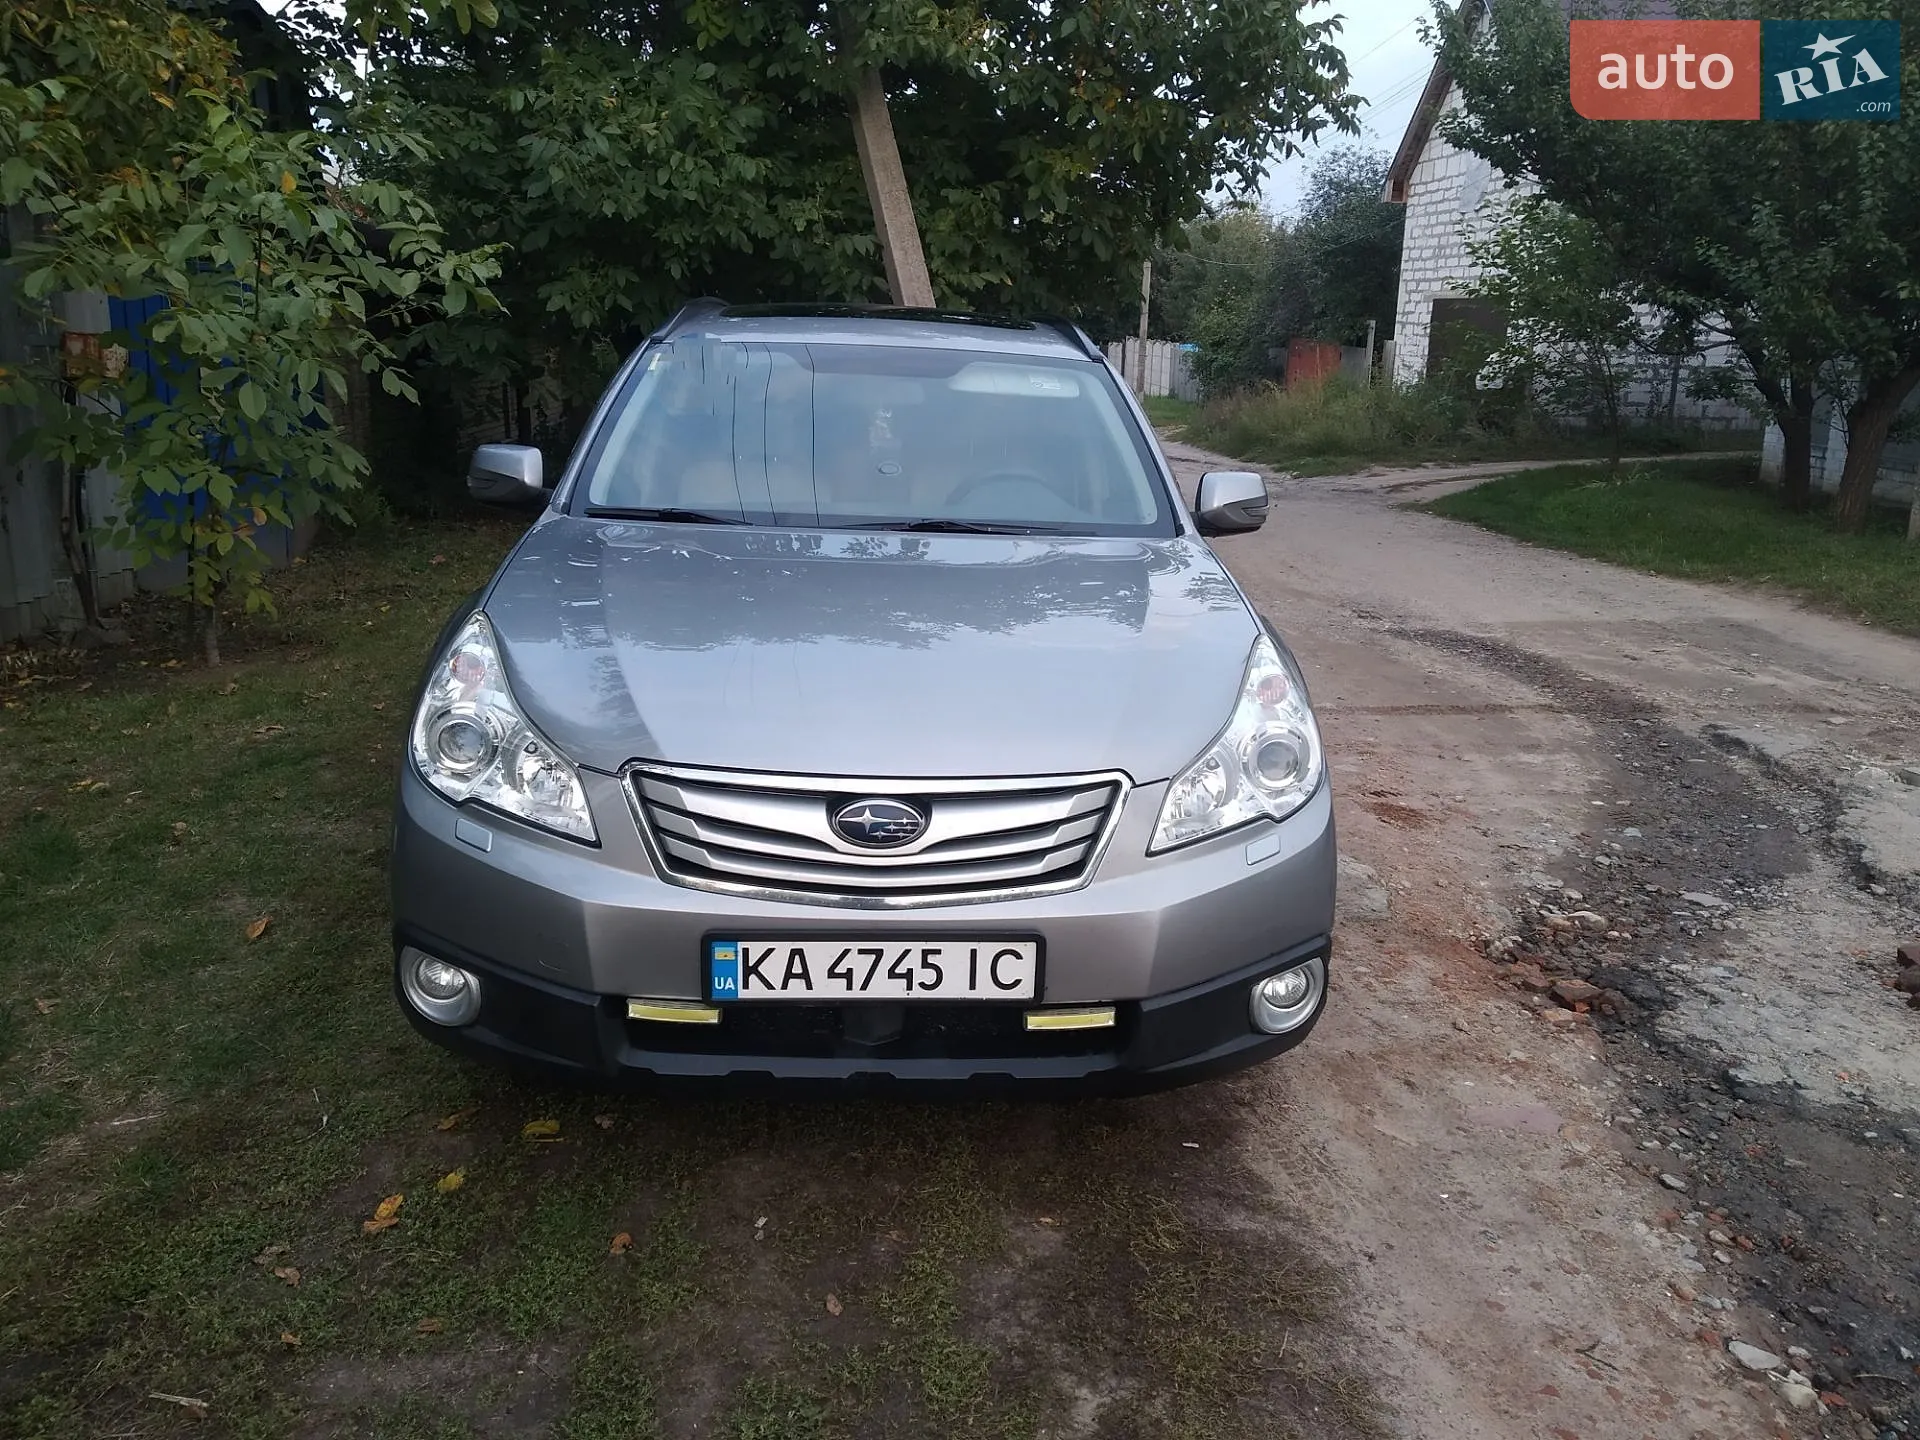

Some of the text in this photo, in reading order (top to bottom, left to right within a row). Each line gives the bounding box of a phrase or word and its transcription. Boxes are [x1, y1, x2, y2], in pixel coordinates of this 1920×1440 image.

[714, 977, 735, 990] UA
[741, 947, 1024, 992] KA 4745 IC
